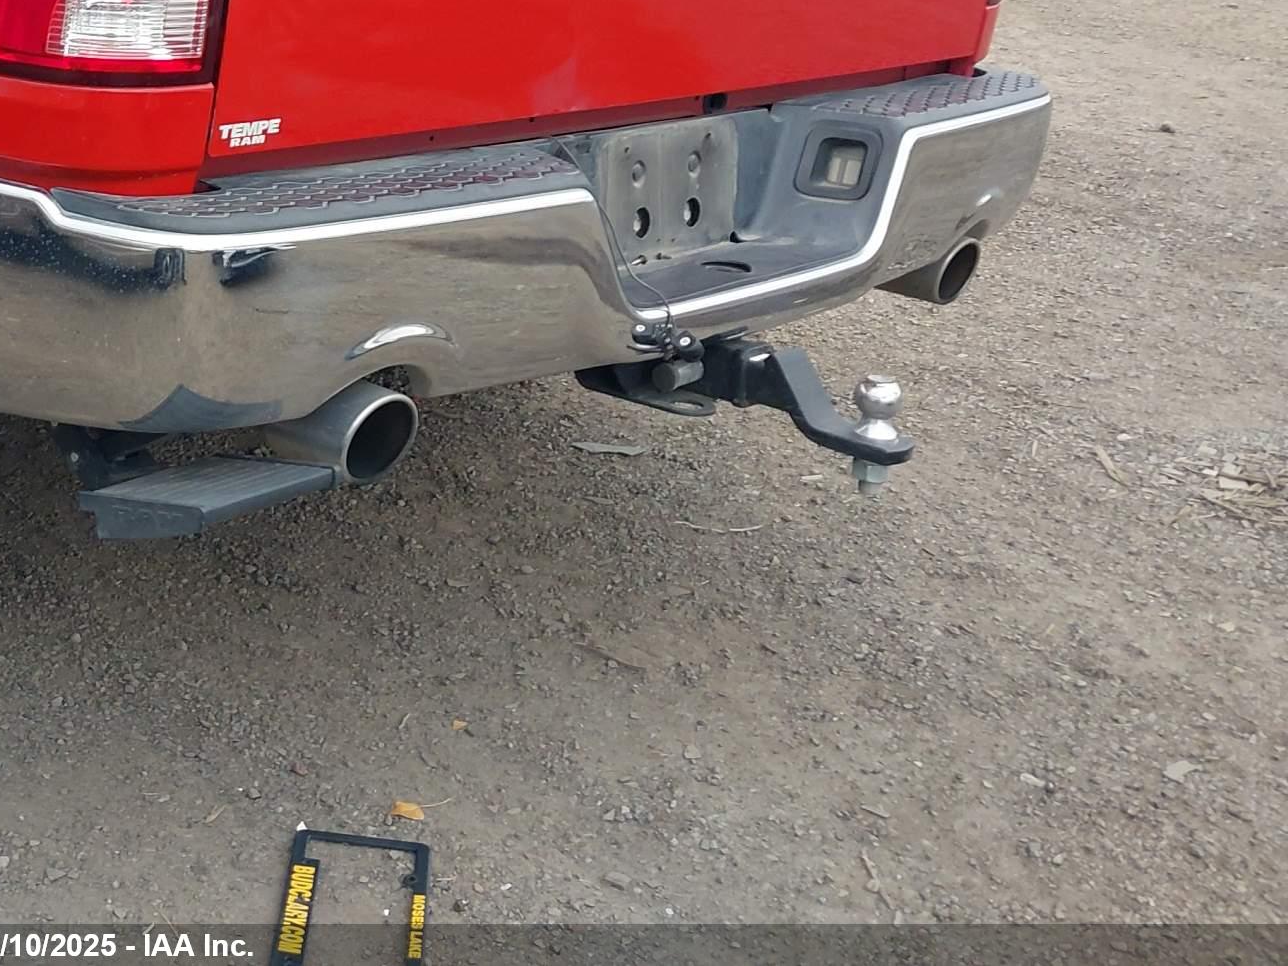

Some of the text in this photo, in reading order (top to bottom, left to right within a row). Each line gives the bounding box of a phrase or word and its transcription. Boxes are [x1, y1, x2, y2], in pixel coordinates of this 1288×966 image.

[219, 118, 281, 139] TEMPE
[229, 134, 266, 148] RAM
[408, 894, 426, 959] MOSES LAKE
